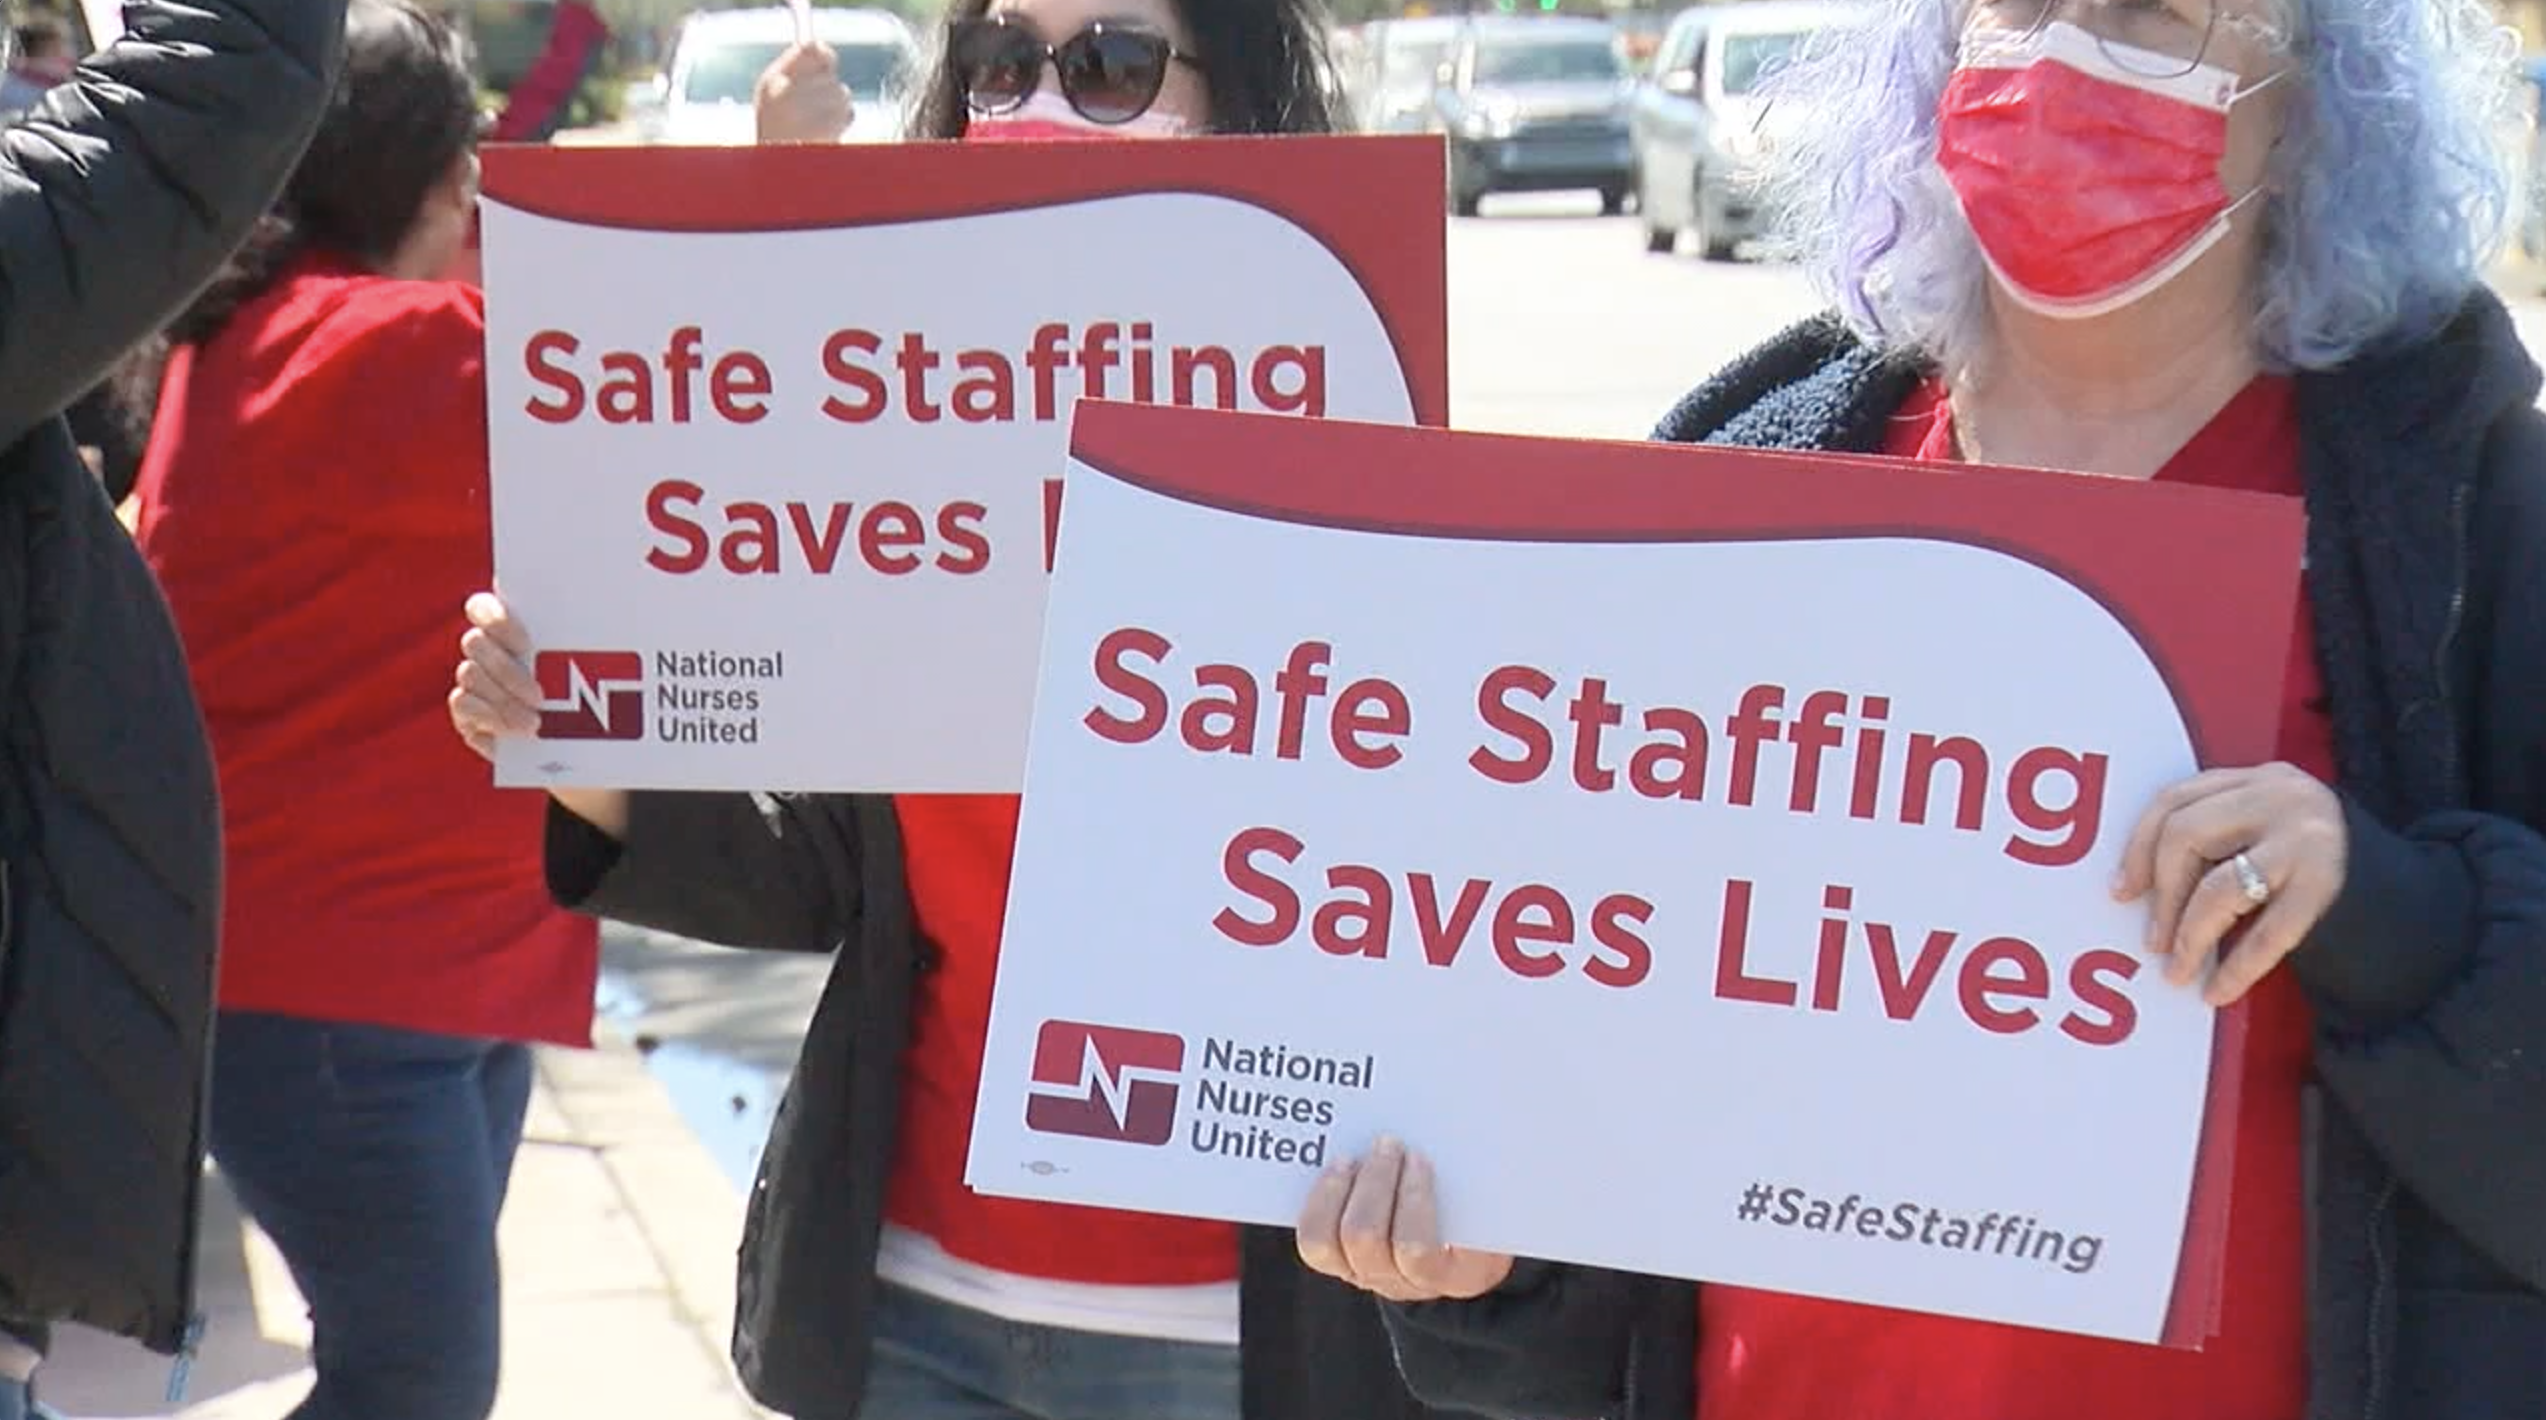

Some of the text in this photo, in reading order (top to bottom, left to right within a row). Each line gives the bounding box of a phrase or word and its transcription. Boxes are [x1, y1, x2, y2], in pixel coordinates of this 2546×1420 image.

[524, 322, 1327, 425] Safe Staffing
[645, 479, 991, 576] Saves
[656, 650, 784, 678] National
[657, 683, 760, 711] Nurses
[658, 716, 759, 744] United
[1083, 627, 2109, 867] Safe Staffing
[1212, 827, 2141, 1046] Saves Lives
[1203, 1037, 1375, 1089] National
[1196, 1078, 1334, 1126] Nurses
[1191, 1119, 1327, 1168] United
[1737, 1182, 2103, 1274] #SafeStaffing
